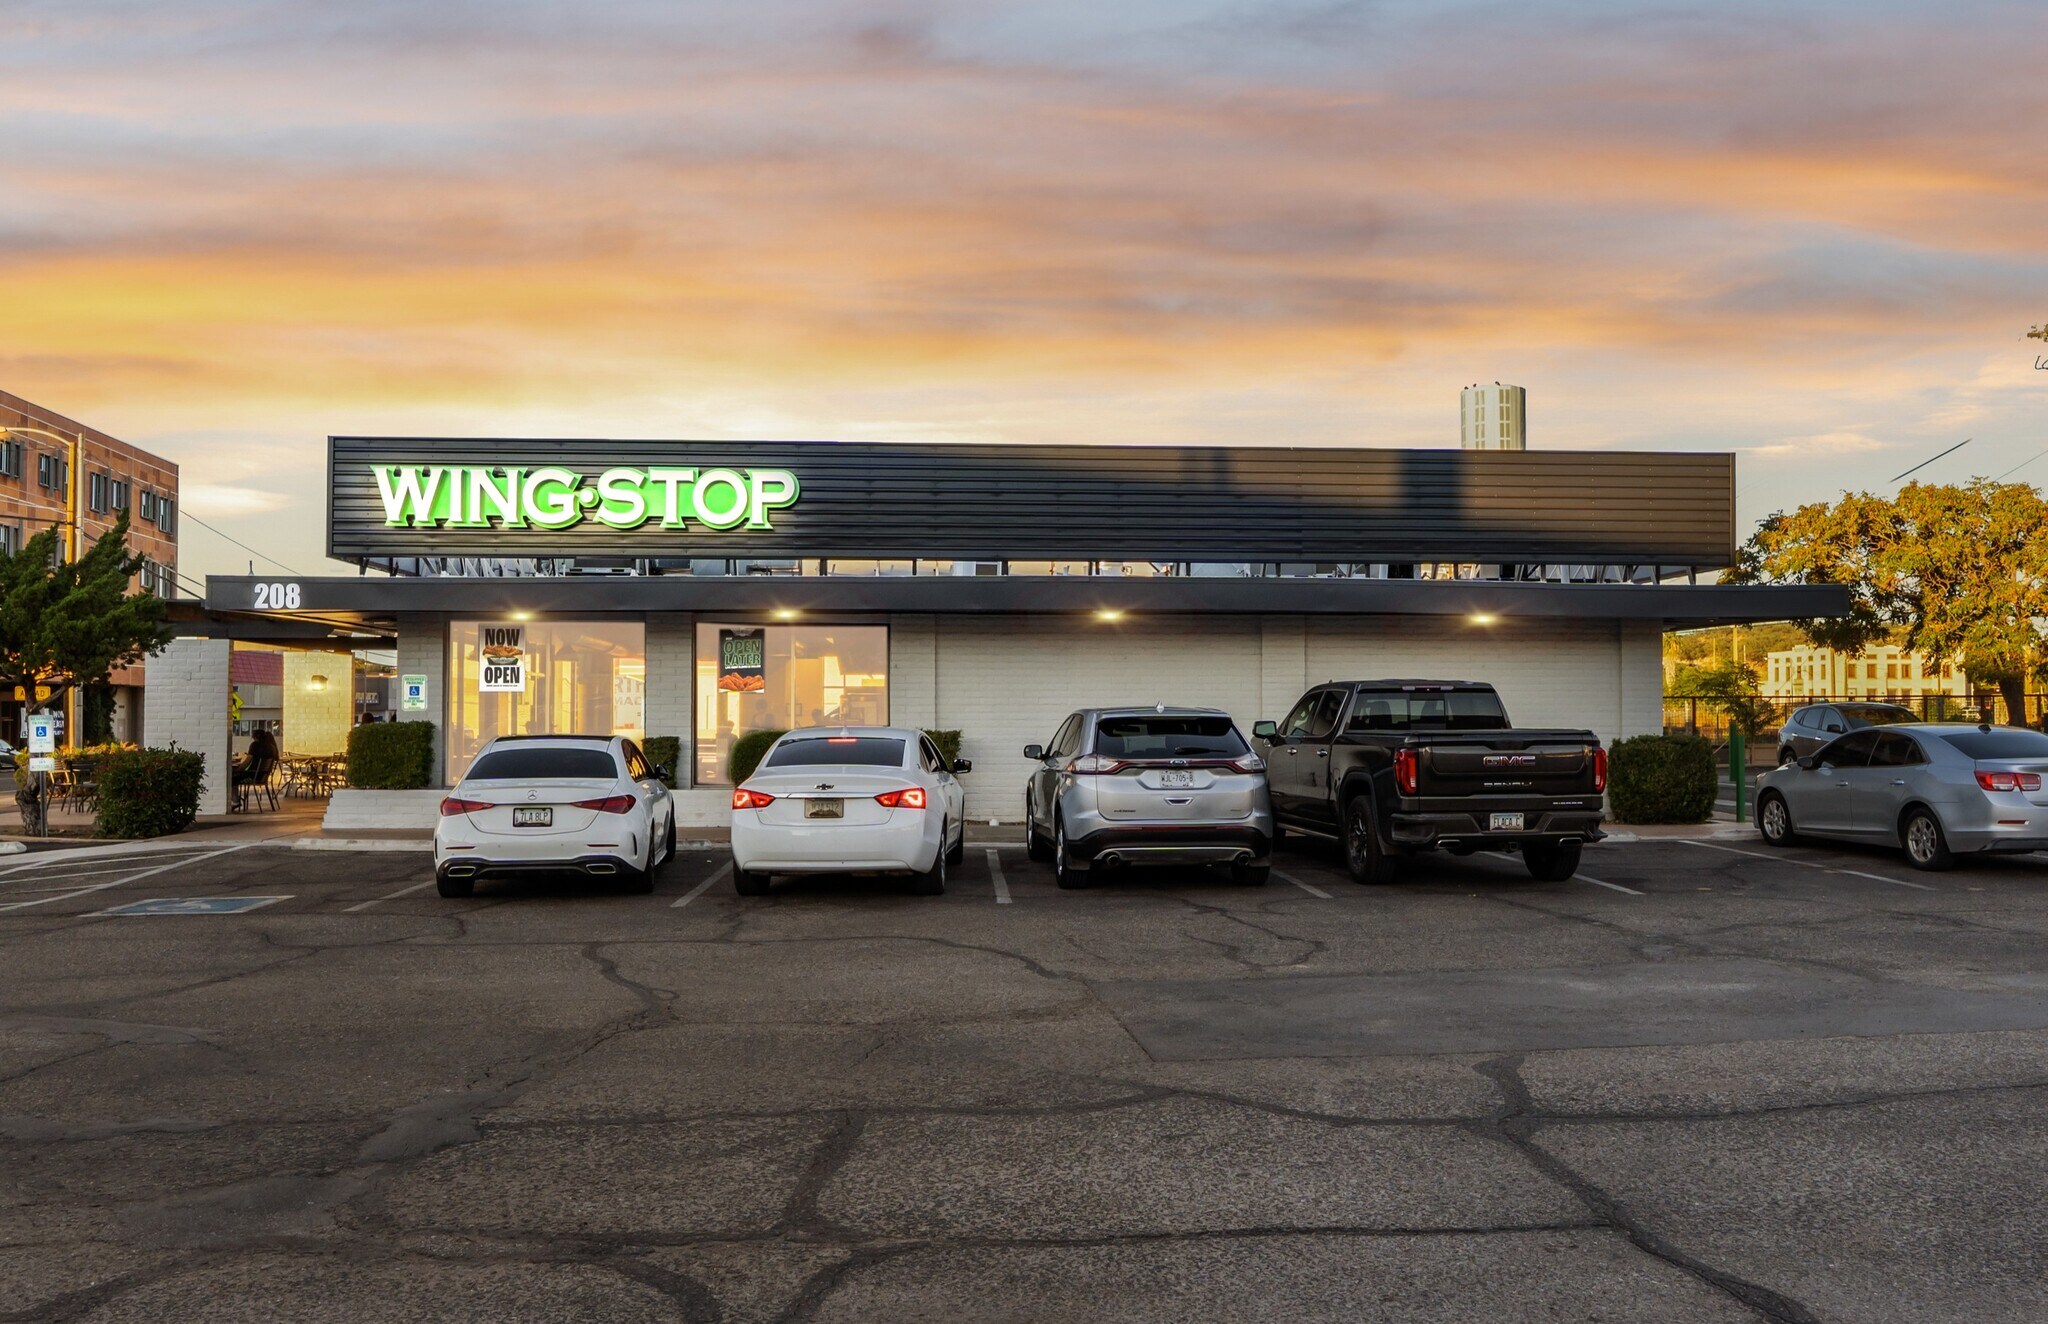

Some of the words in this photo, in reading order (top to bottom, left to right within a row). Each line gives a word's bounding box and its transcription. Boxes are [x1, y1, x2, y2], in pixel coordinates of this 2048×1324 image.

[253, 583, 301, 609] 208
[485, 628, 520, 646] NOW
[724, 639, 761, 654] OPEN
[725, 653, 761, 667] LATER
[484, 667, 520, 684] OPEN
[20, 689, 45, 697] AAD
[1483, 755, 1535, 767] GMC
